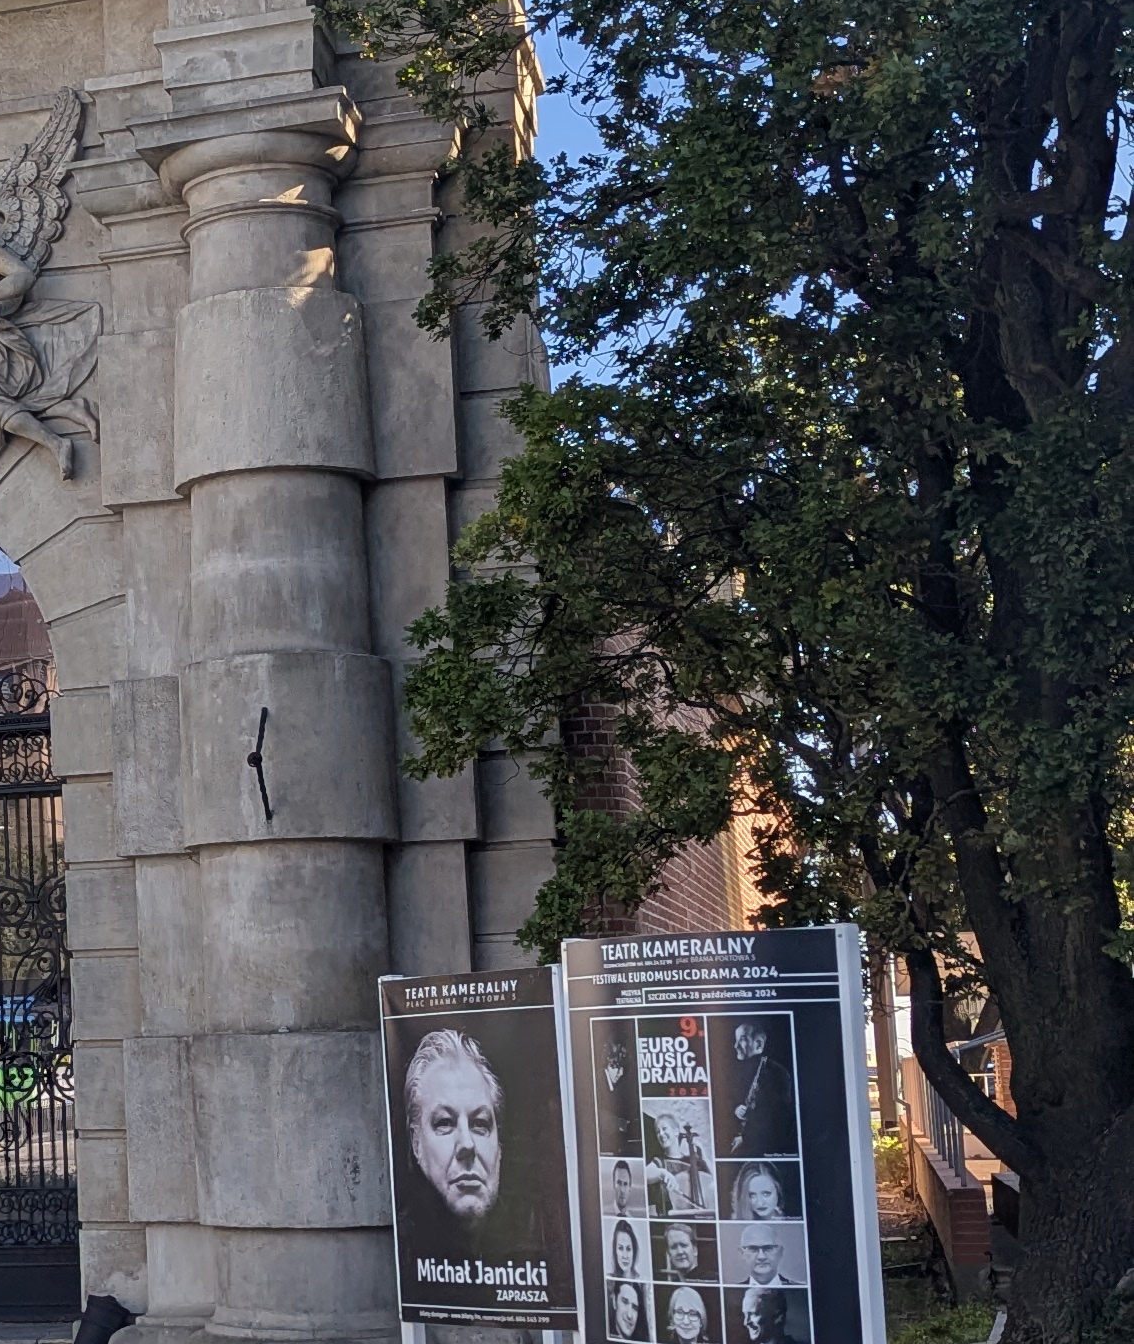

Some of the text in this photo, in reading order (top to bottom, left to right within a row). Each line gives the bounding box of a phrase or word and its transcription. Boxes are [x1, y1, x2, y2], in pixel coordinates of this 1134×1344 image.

[601, 937, 756, 962] TEATR KAMERALNY
[592, 966, 779, 985] FESTIWAL EUROMUSICDRAMA 2024
[405, 980, 518, 1000] TEATR KAMERALNY
[680, 1016, 704, 1037] 9.
[638, 1036, 689, 1053] EURO
[639, 1051, 696, 1068] MUSIC
[640, 1066, 709, 1083] DRAMA
[417, 1258, 548, 1286] Michał Janicki
[496, 1289, 549, 1303] ZAPRASZA
